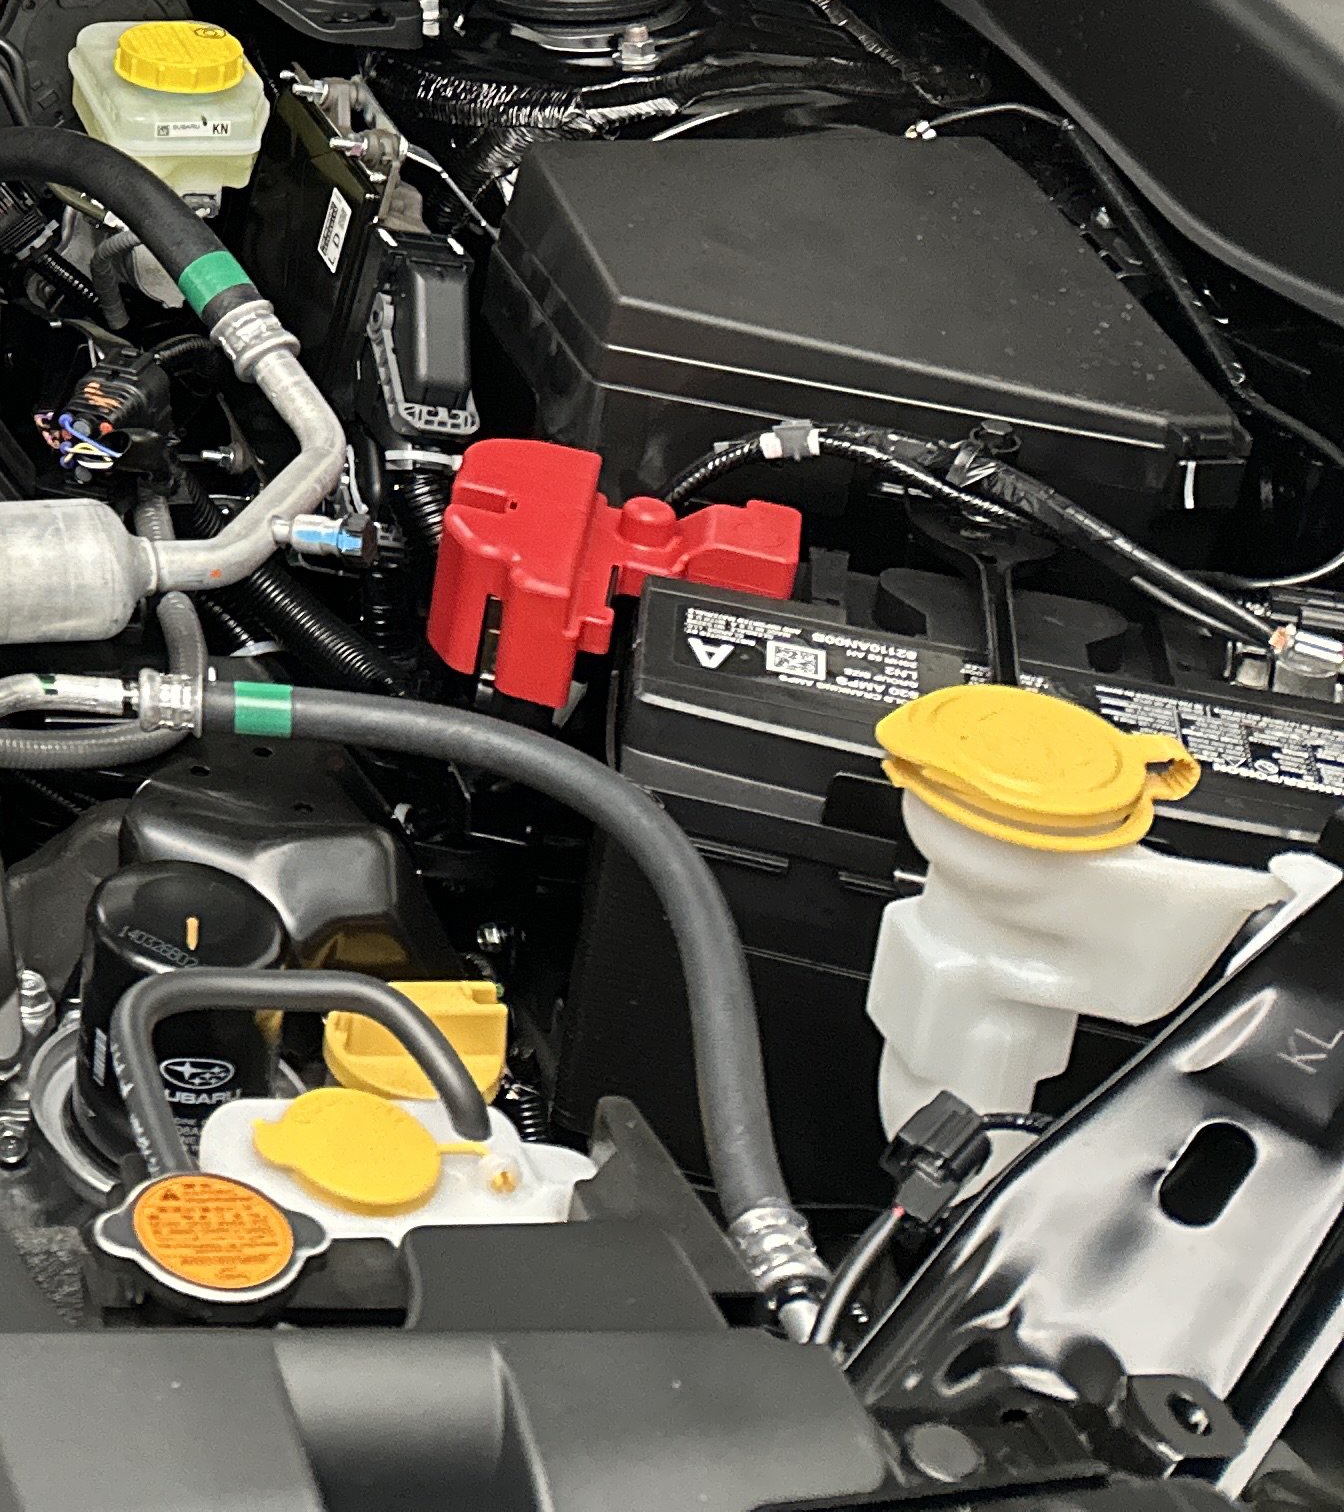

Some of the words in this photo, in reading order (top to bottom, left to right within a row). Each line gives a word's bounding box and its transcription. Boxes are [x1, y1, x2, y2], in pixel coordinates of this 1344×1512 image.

[212, 123, 229, 135] KN
[778, 674, 814, 687] AMPS
[836, 676, 886, 693] AMPS
[873, 675, 919, 689] GROUP
[164, 1088, 242, 1105] UBARU
